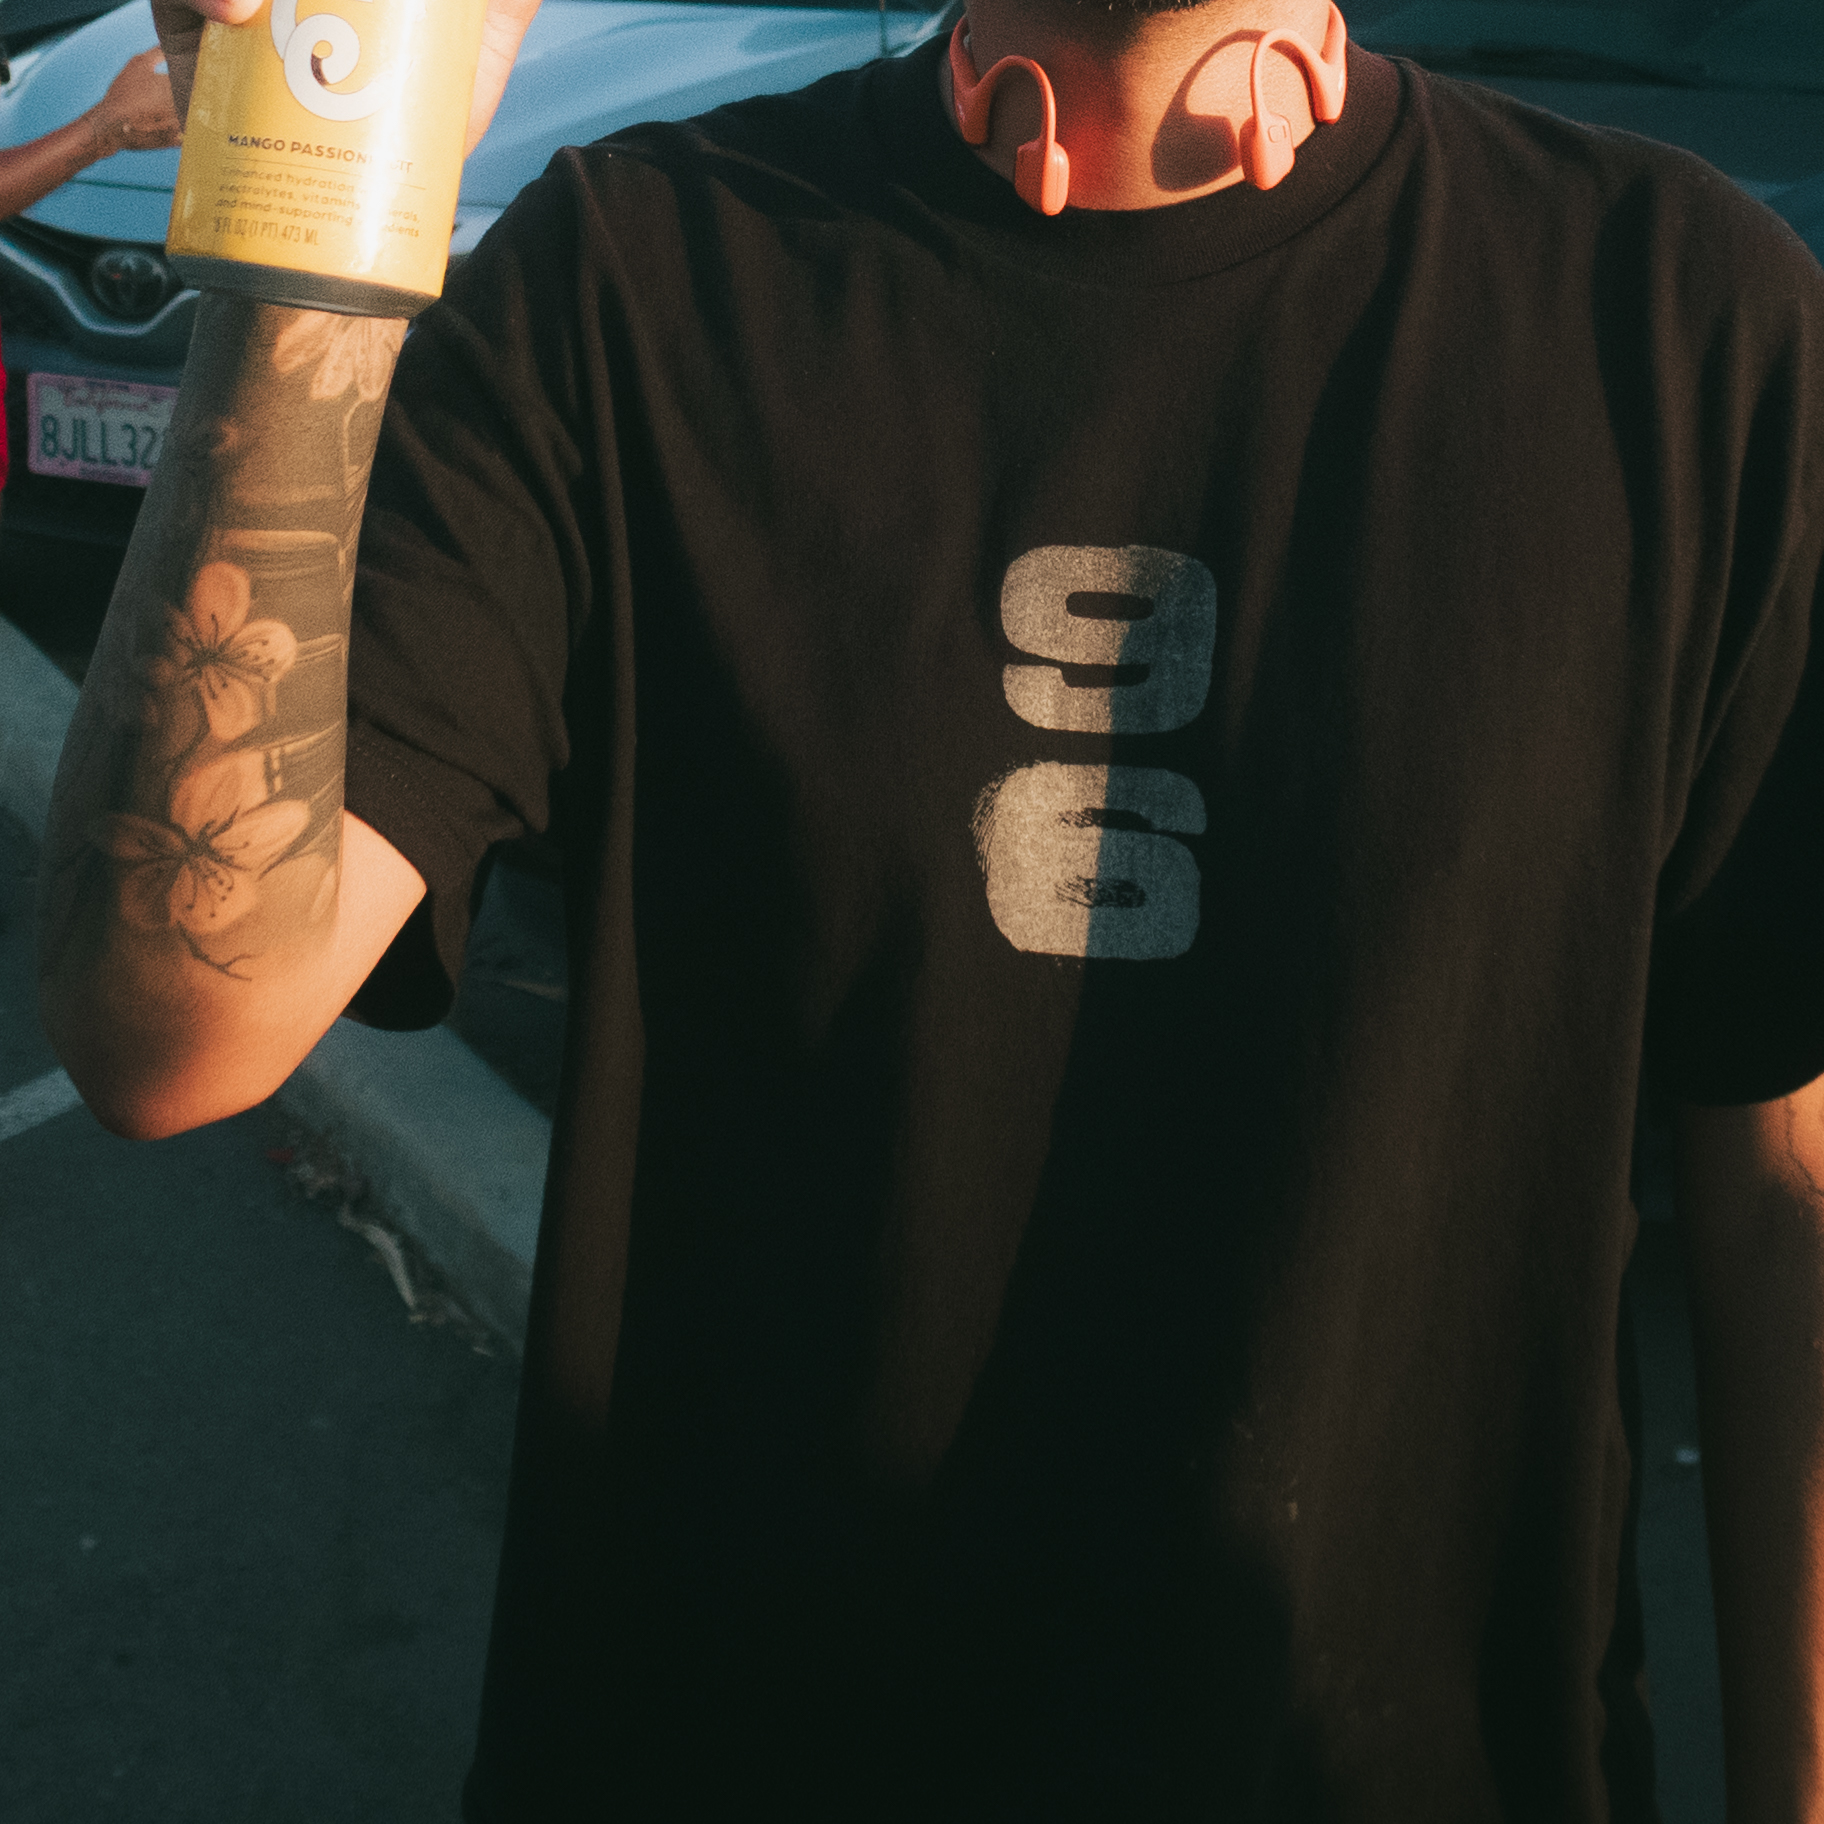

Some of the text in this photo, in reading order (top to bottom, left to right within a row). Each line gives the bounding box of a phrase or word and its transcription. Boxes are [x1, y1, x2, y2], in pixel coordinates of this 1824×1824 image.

[228, 135, 413, 173] MANGO PASSIONIT
[282, 224, 301, 243] 473
[41, 414, 162, 469] 8JLL32
